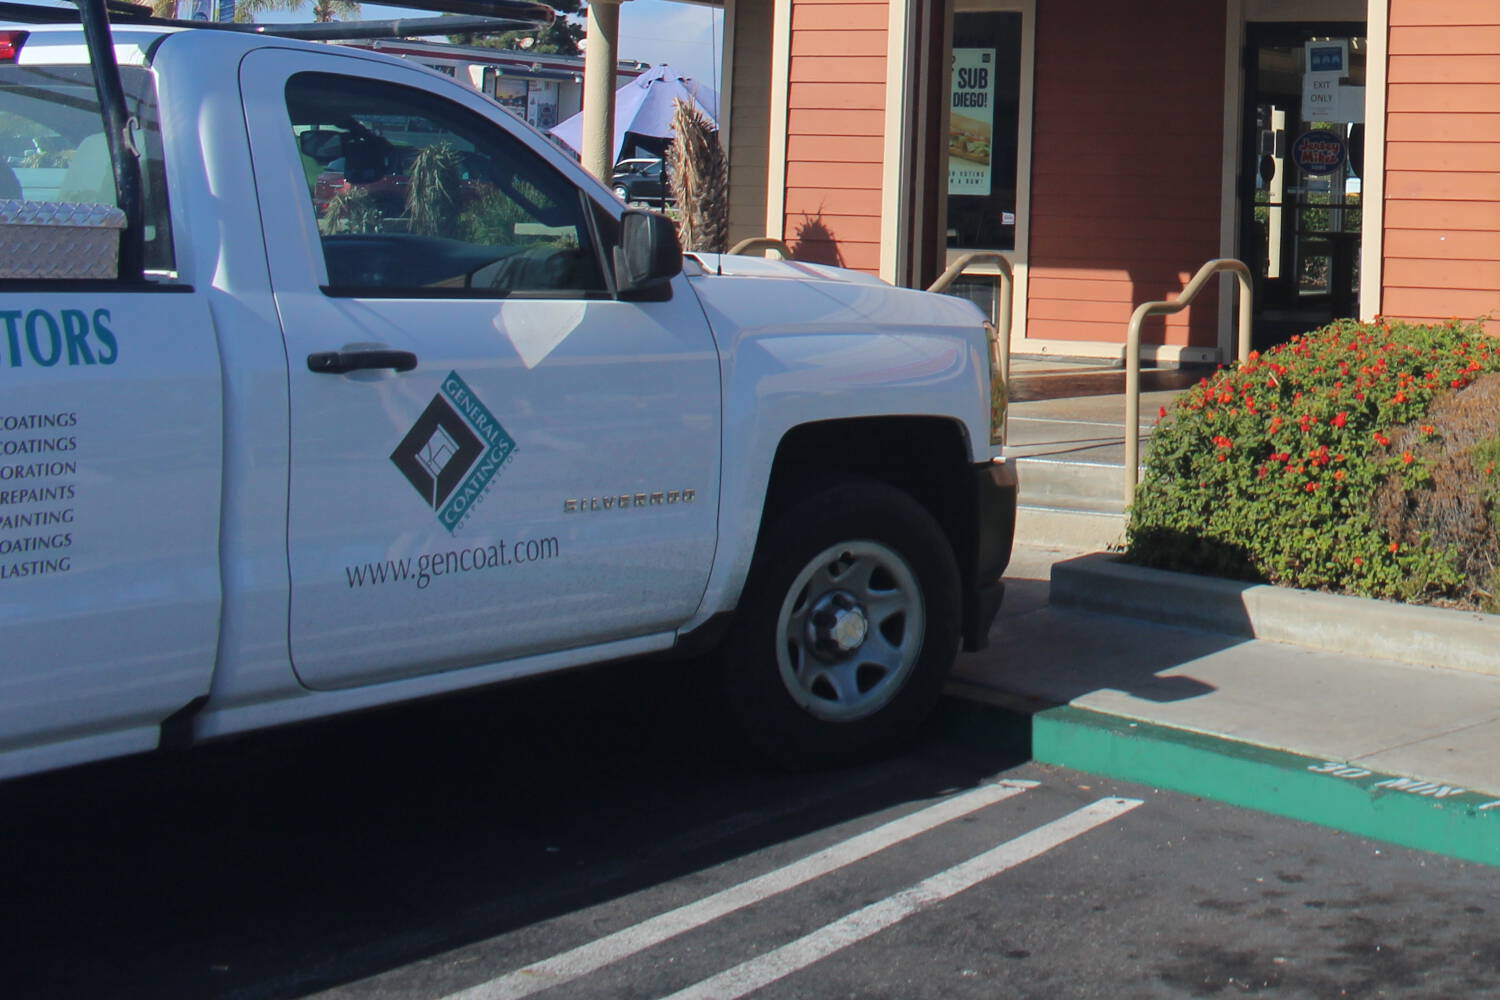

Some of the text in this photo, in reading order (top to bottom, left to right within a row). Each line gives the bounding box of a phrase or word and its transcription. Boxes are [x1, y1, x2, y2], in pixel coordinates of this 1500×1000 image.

[958, 68, 988, 89] SUB
[1313, 80, 1330, 90] EXIT
[953, 92, 987, 108] DIEGO!
[1310, 94, 1332, 104] ONLY
[0, 308, 119, 368] TORS
[444, 438, 510, 524] COATINGS
[346, 535, 560, 590] www.gencoat.com
[1374, 777, 1467, 799] MIN
